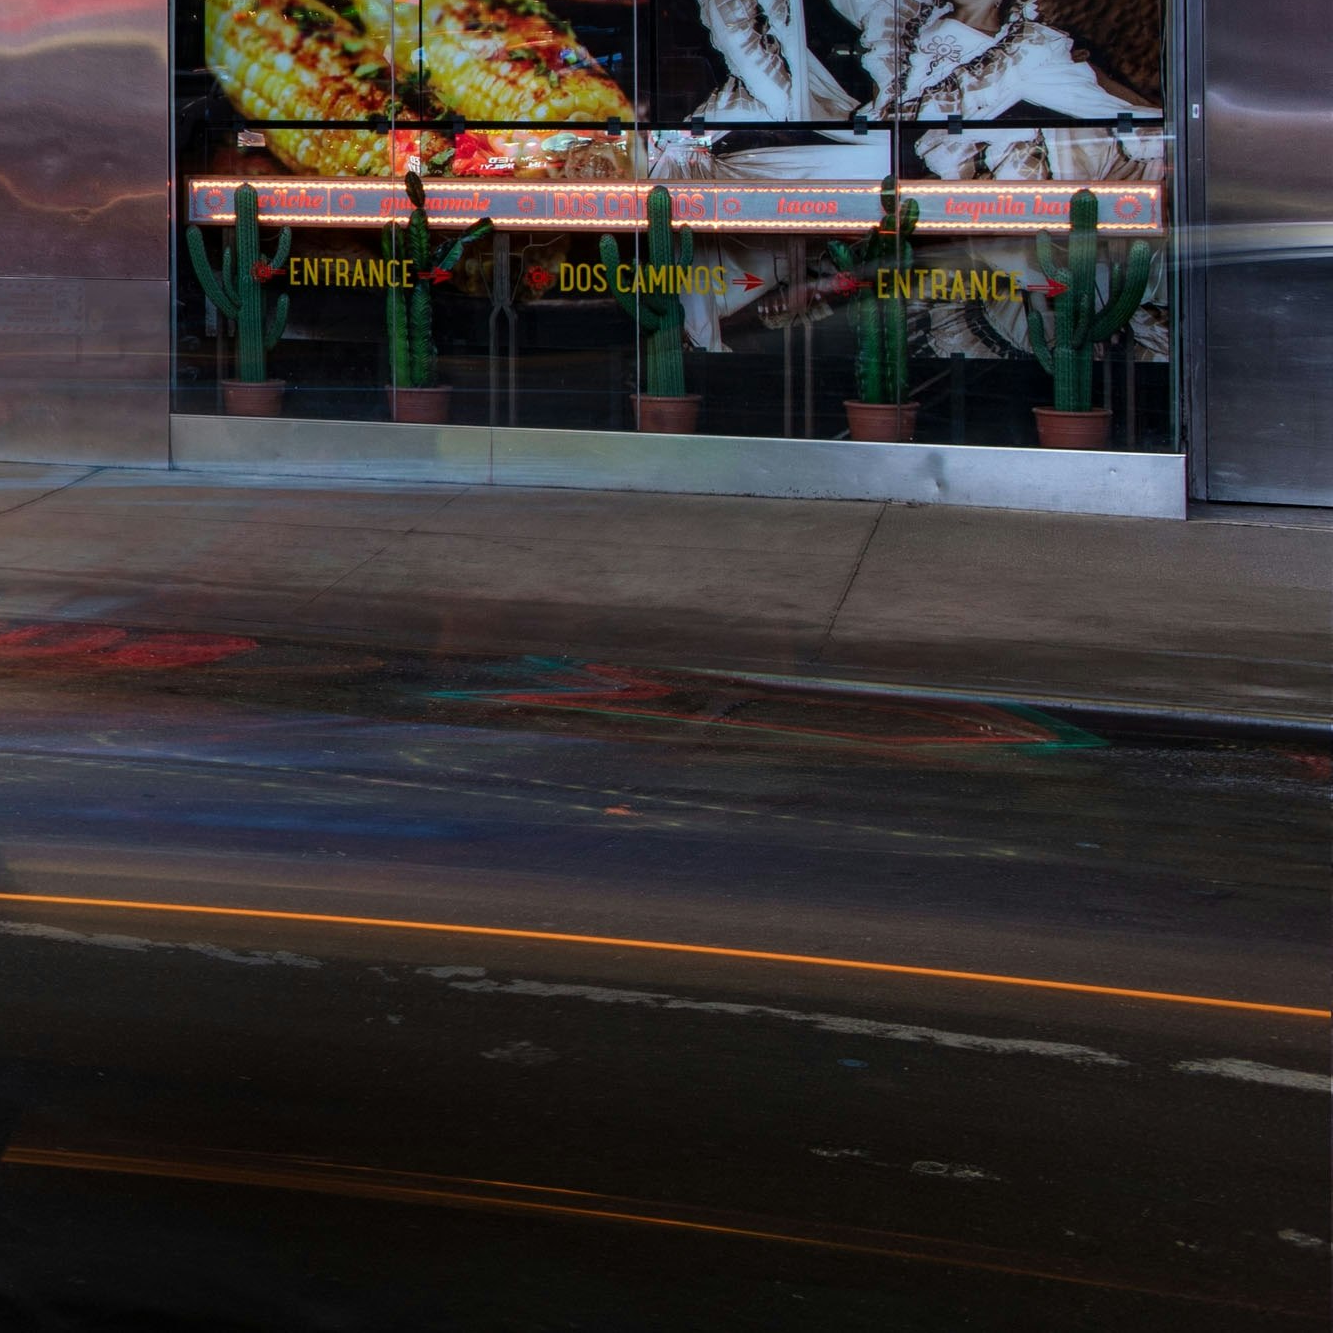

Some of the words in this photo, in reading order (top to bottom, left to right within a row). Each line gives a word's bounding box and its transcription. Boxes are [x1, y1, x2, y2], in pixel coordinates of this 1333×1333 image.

[258, 189, 324, 209] eviche
[380, 191, 491, 216] guamole
[553, 192, 598, 217] DOS
[777, 196, 838, 215] tacos
[944, 194, 1026, 223] tequila
[289, 257, 414, 288] ENTRANCE
[560, 263, 608, 293] DOS
[616, 263, 727, 297] CAMINOS
[877, 268, 1024, 303] ENTRANCE
